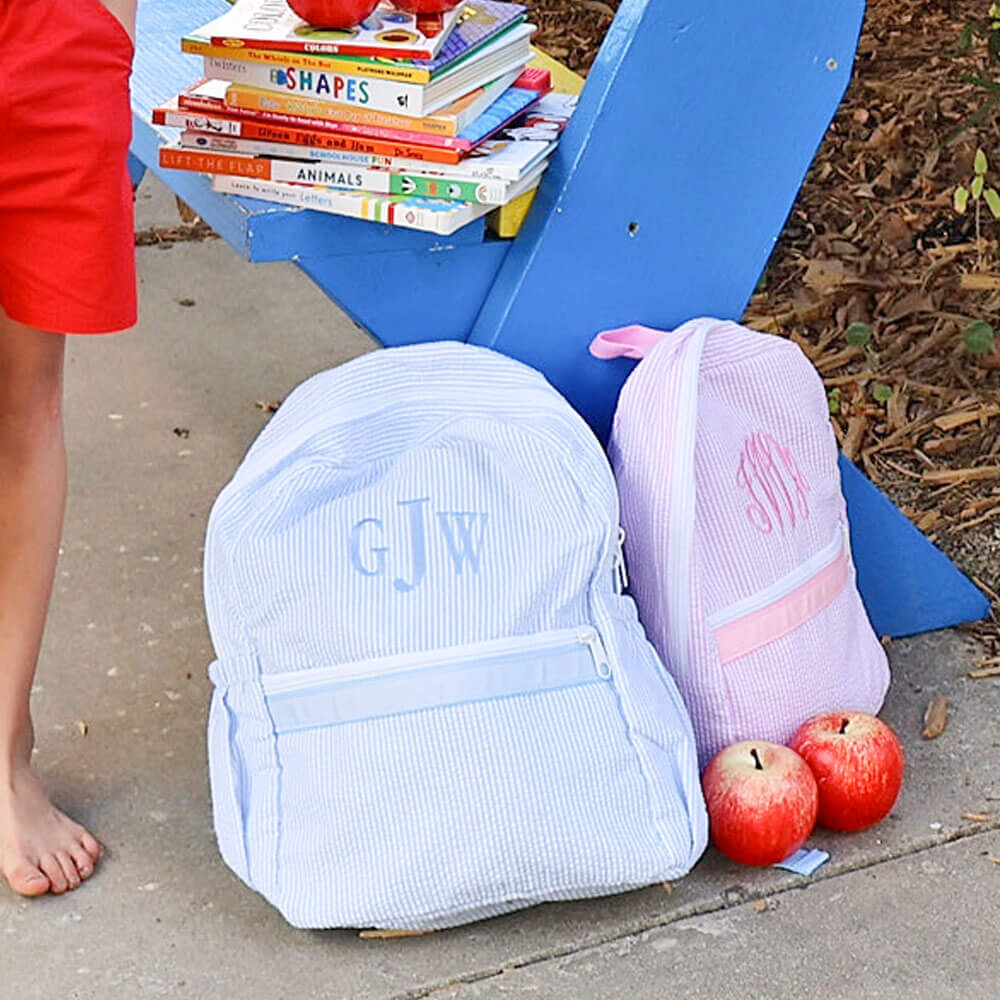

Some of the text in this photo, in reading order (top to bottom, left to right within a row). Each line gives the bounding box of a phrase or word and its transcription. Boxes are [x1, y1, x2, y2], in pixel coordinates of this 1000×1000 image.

[286, 66, 369, 104] SHAPES
[259, 126, 290, 140] Green
[296, 131, 323, 146] Eggs
[327, 138, 347, 148] and
[162, 154, 266, 174] LIFT THE FLAP
[309, 151, 393, 166] SCHOOLHOUSE FUN
[296, 168, 364, 187] ANIMALS
